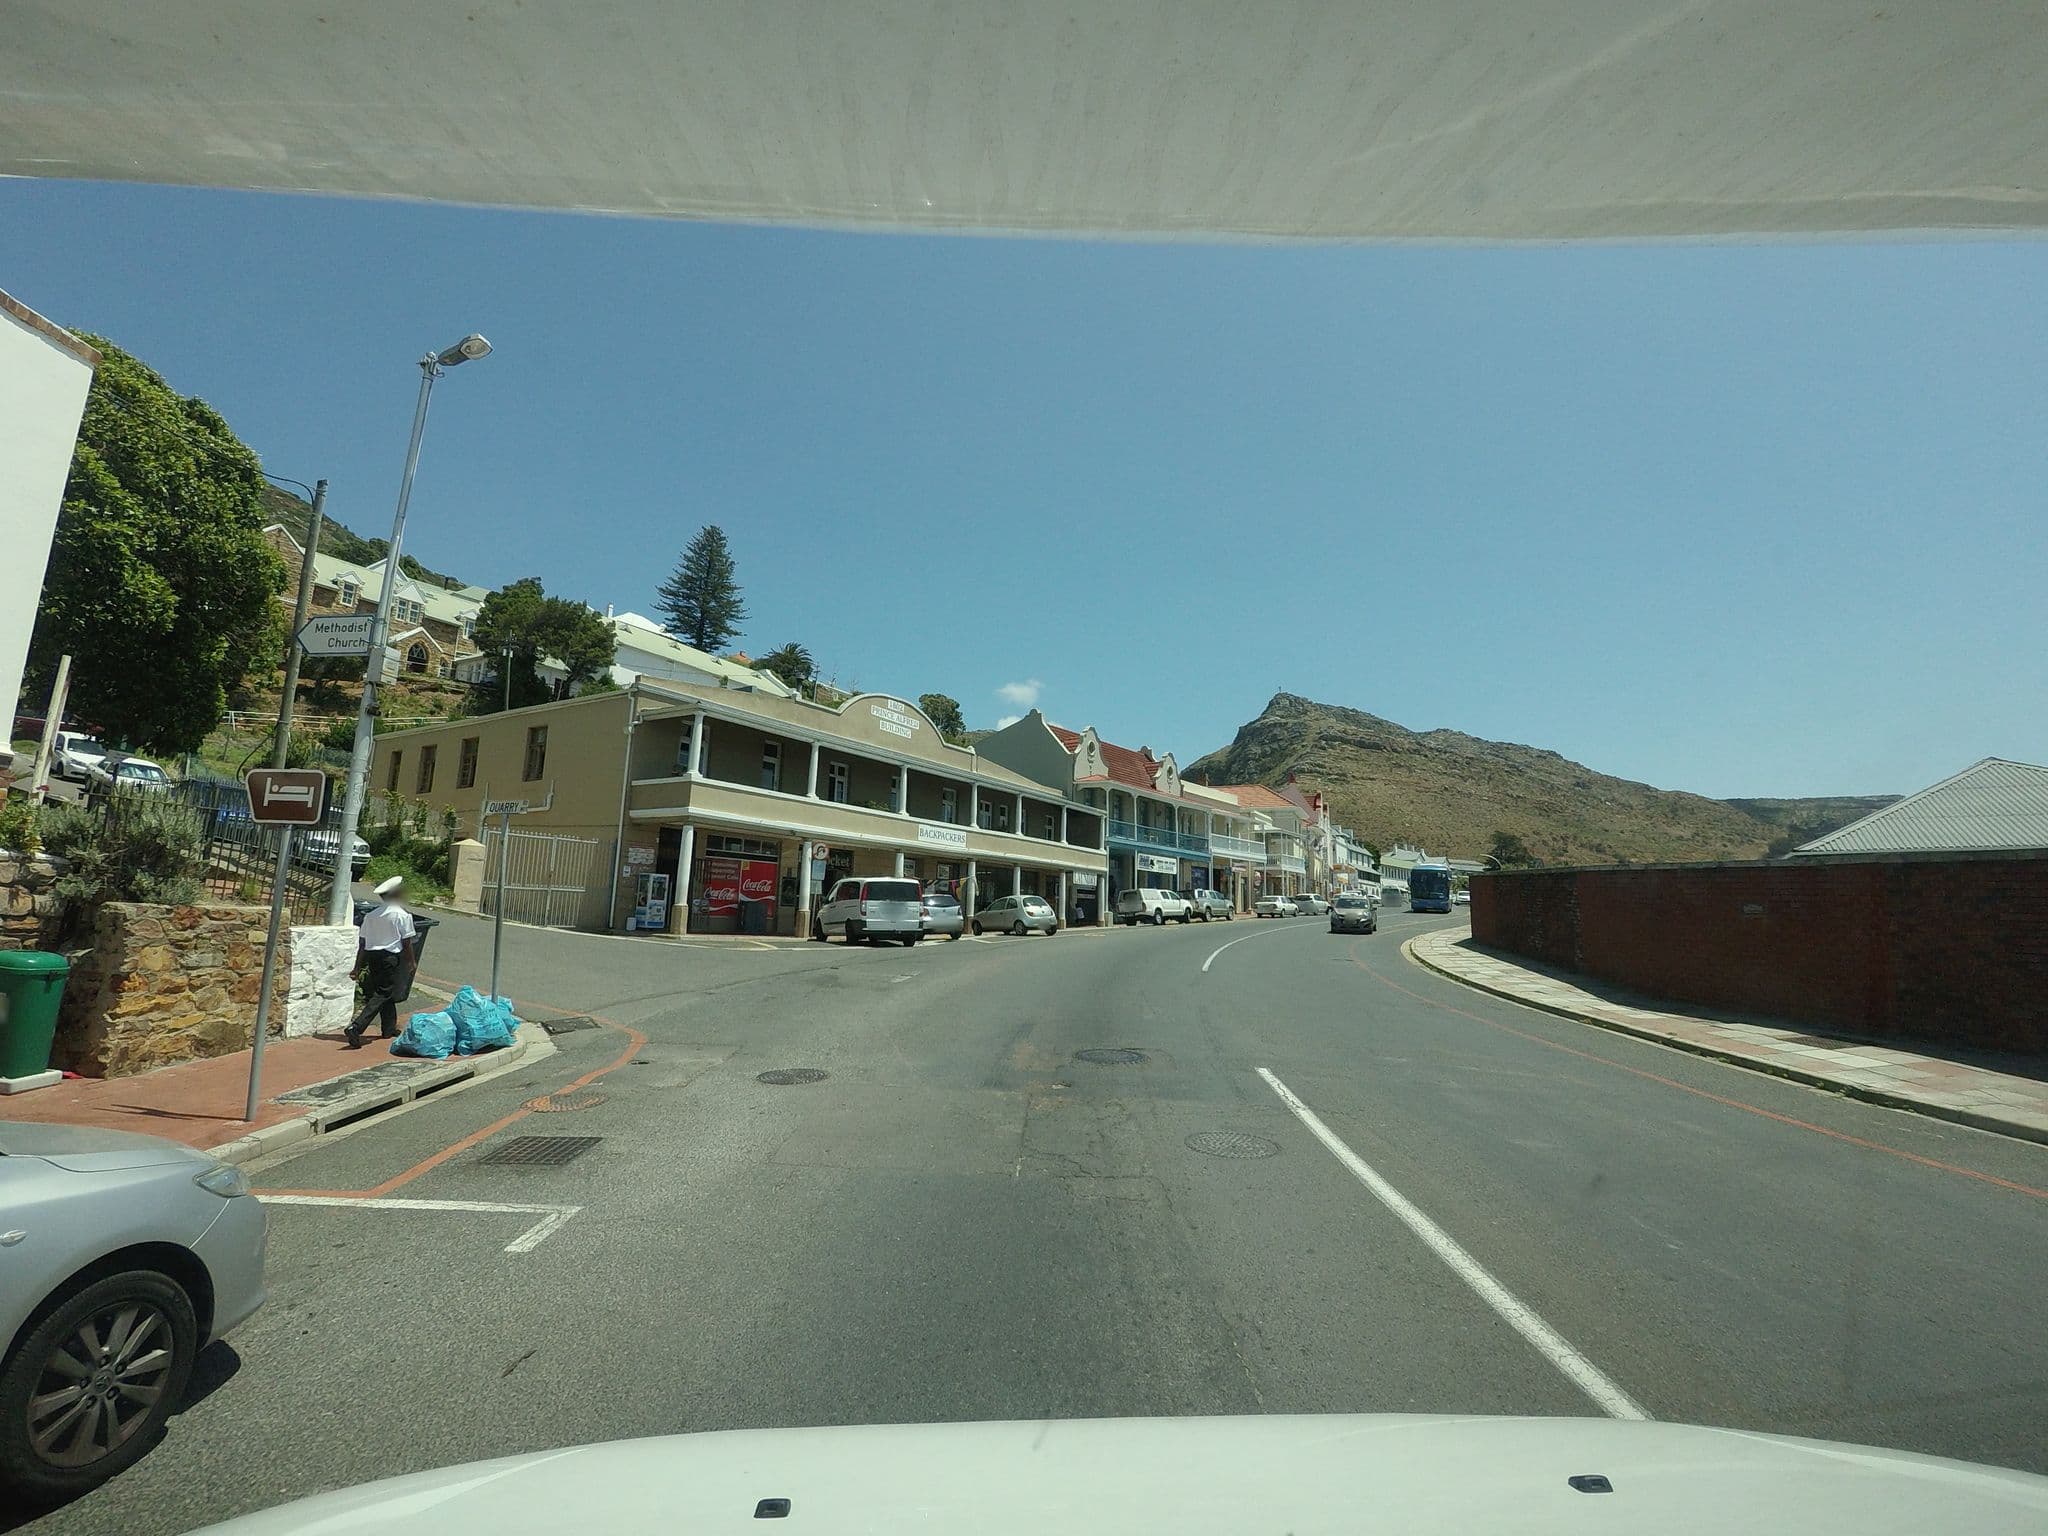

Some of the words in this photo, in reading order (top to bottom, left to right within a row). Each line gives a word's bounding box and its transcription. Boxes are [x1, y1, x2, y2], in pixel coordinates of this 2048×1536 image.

[314, 622, 368, 634] Methodist
[327, 637, 365, 648] Church
[872, 705, 895, 721] PRINCE
[895, 713, 919, 729] ALFRED
[880, 720, 911, 738] BUILDING
[489, 802, 520, 813] QUARRY
[919, 827, 966, 844] BACKPACKERS
